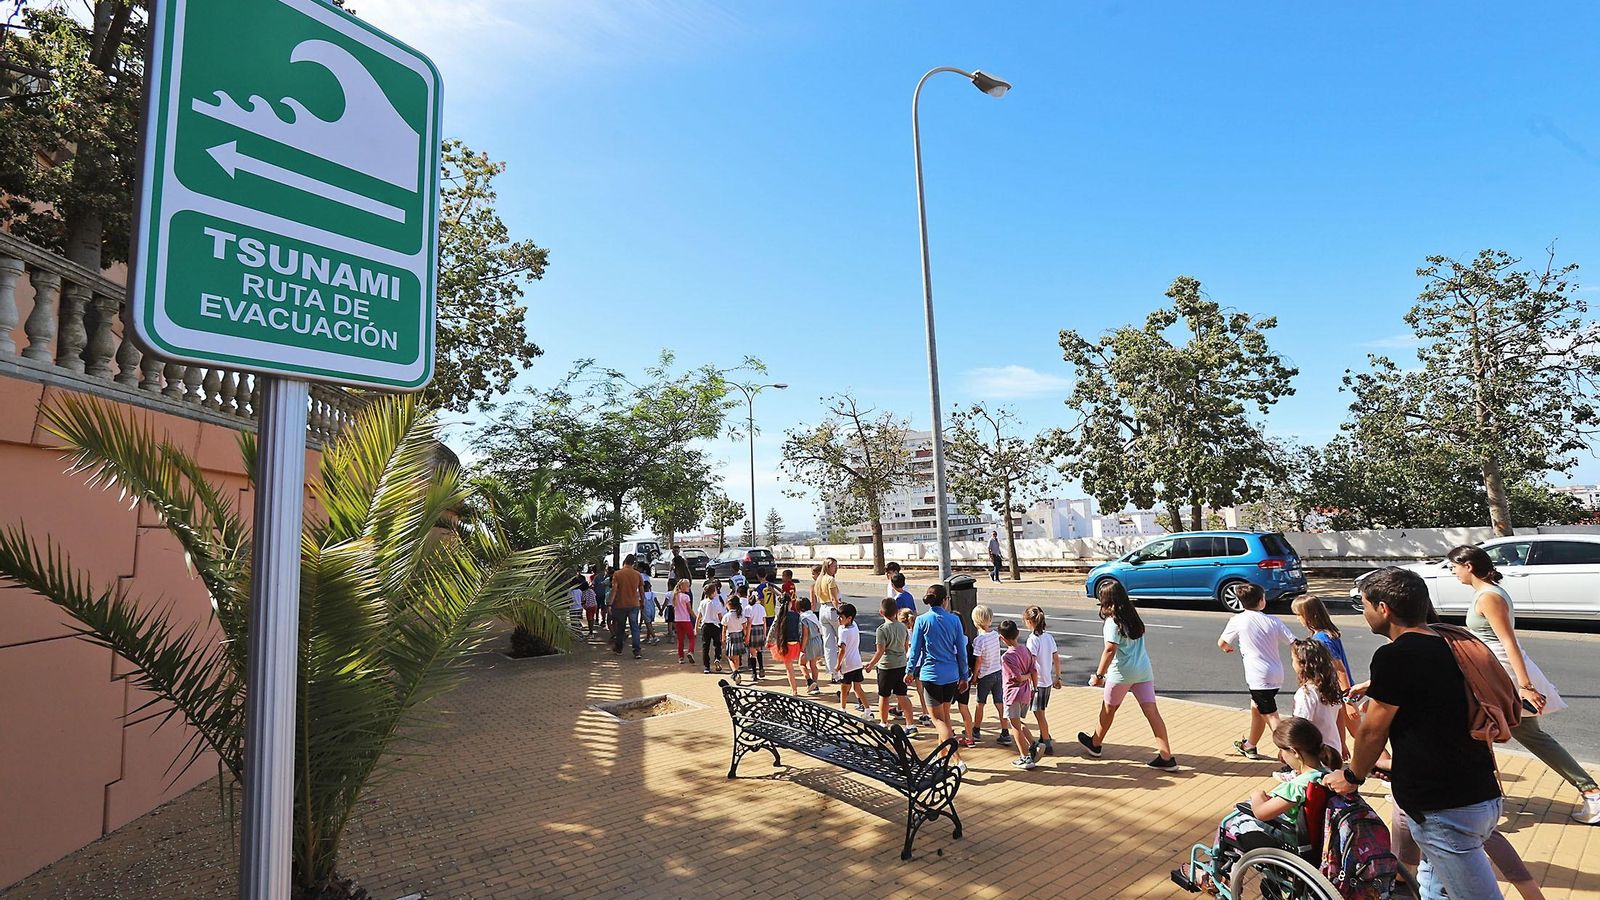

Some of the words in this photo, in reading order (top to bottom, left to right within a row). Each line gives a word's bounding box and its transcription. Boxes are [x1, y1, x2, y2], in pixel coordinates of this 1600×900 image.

[203, 227, 400, 302] TSUNAMI
[200, 293, 398, 351] EVACUACIÓN
[242, 273, 326, 311] RUTA
[333, 294, 370, 321] DE
